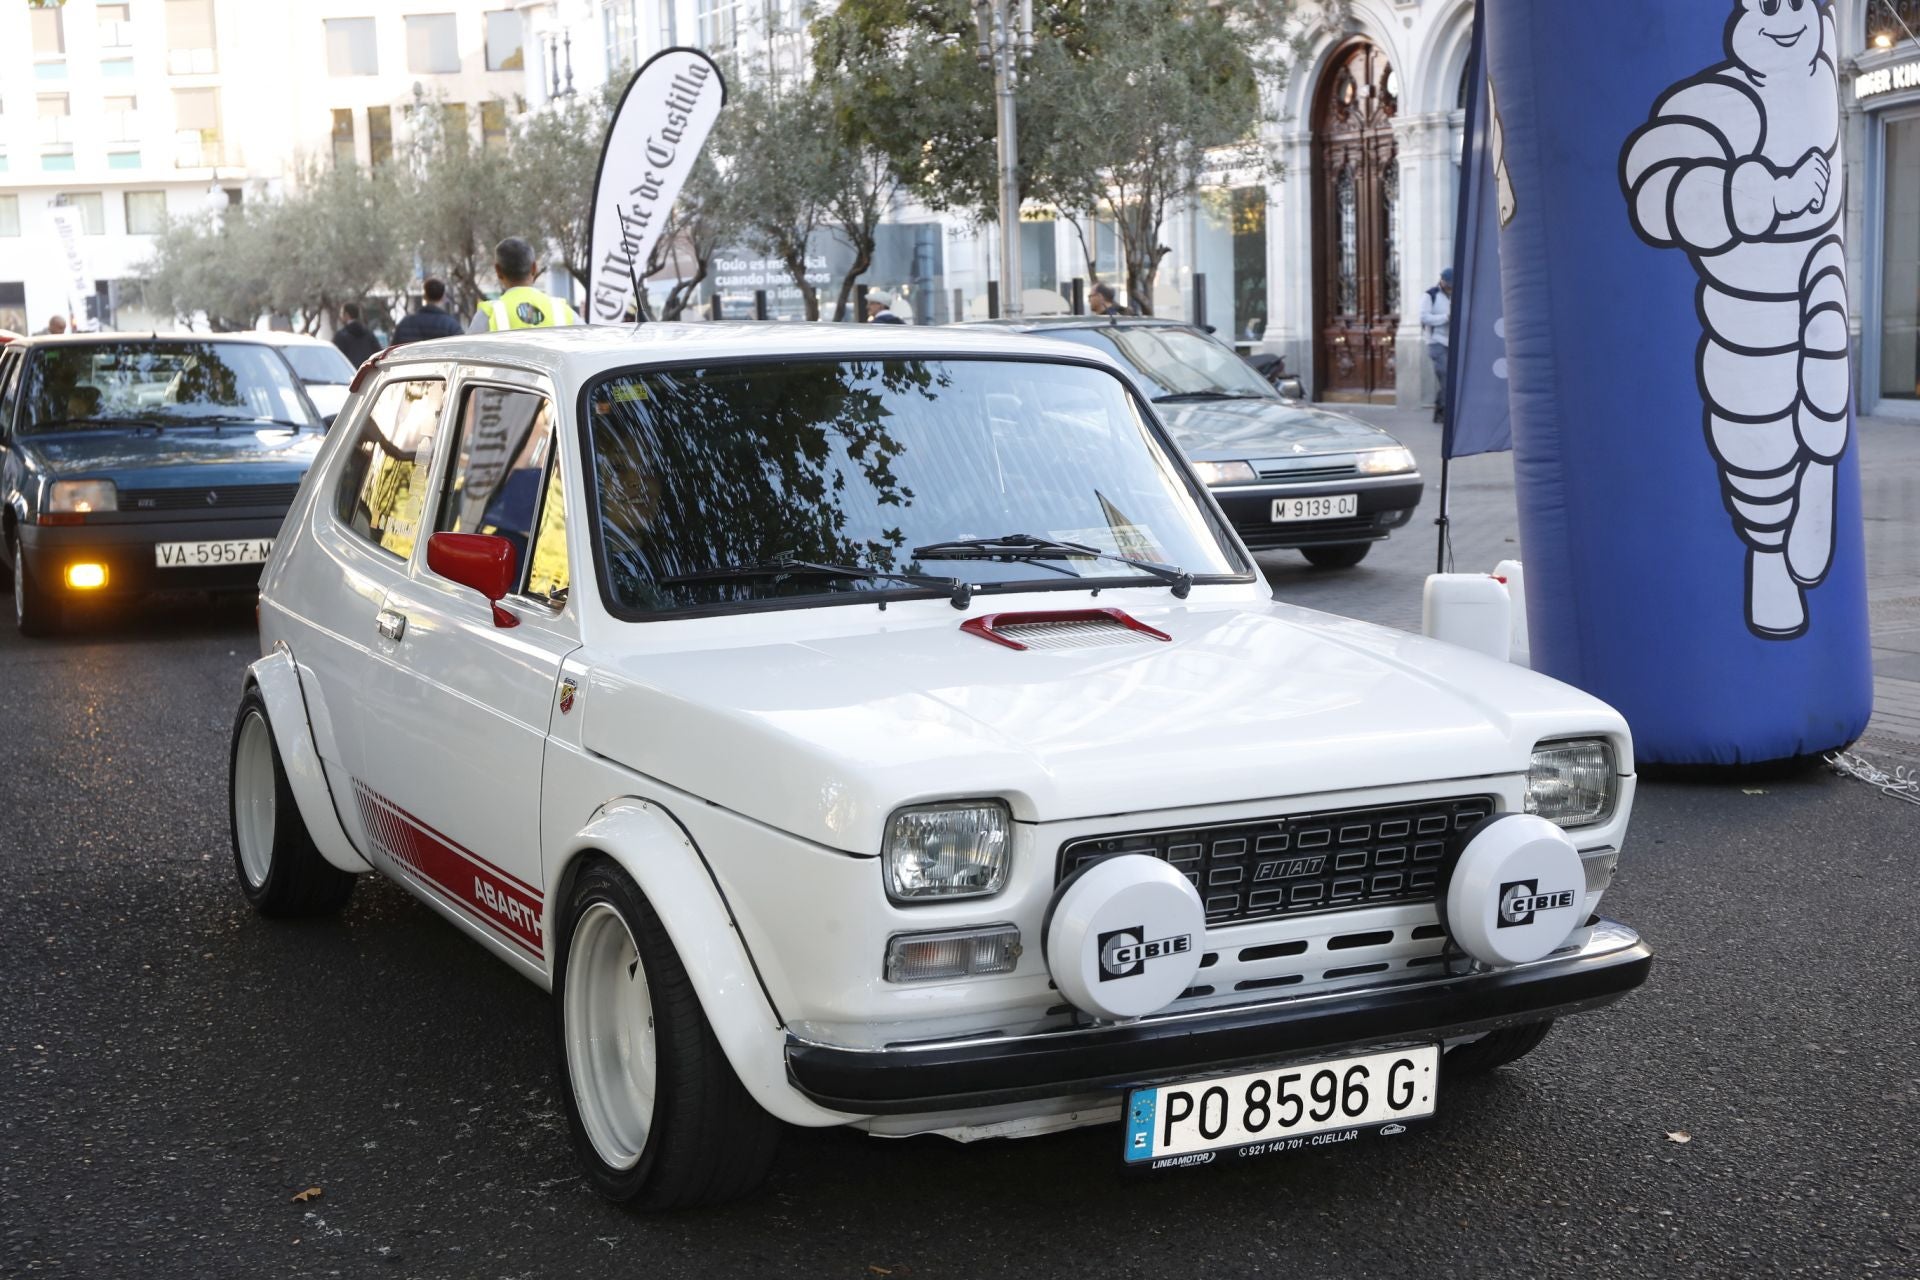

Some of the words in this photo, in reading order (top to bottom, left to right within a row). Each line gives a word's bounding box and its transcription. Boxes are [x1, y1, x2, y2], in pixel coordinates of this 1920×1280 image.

[644, 62, 710, 169] Castilla
[630, 171, 664, 202] de
[602, 204, 652, 278] Norte
[714, 258, 747, 271] Todo
[749, 259, 765, 270] es
[715, 273, 765, 287] cuando
[594, 281, 628, 320] El
[1260, 859, 1322, 878] FIAT
[474, 875, 543, 937] ABARTH
[1163, 1085, 1229, 1147] PO
[1242, 1064, 1370, 1133] 8596
[1386, 1058, 1415, 1111] G
[1248, 1144, 1266, 1156] 921
[1268, 1141, 1285, 1153] 140
[1287, 1138, 1303, 1150] 701
[1312, 1130, 1358, 1146] CUELLAR
